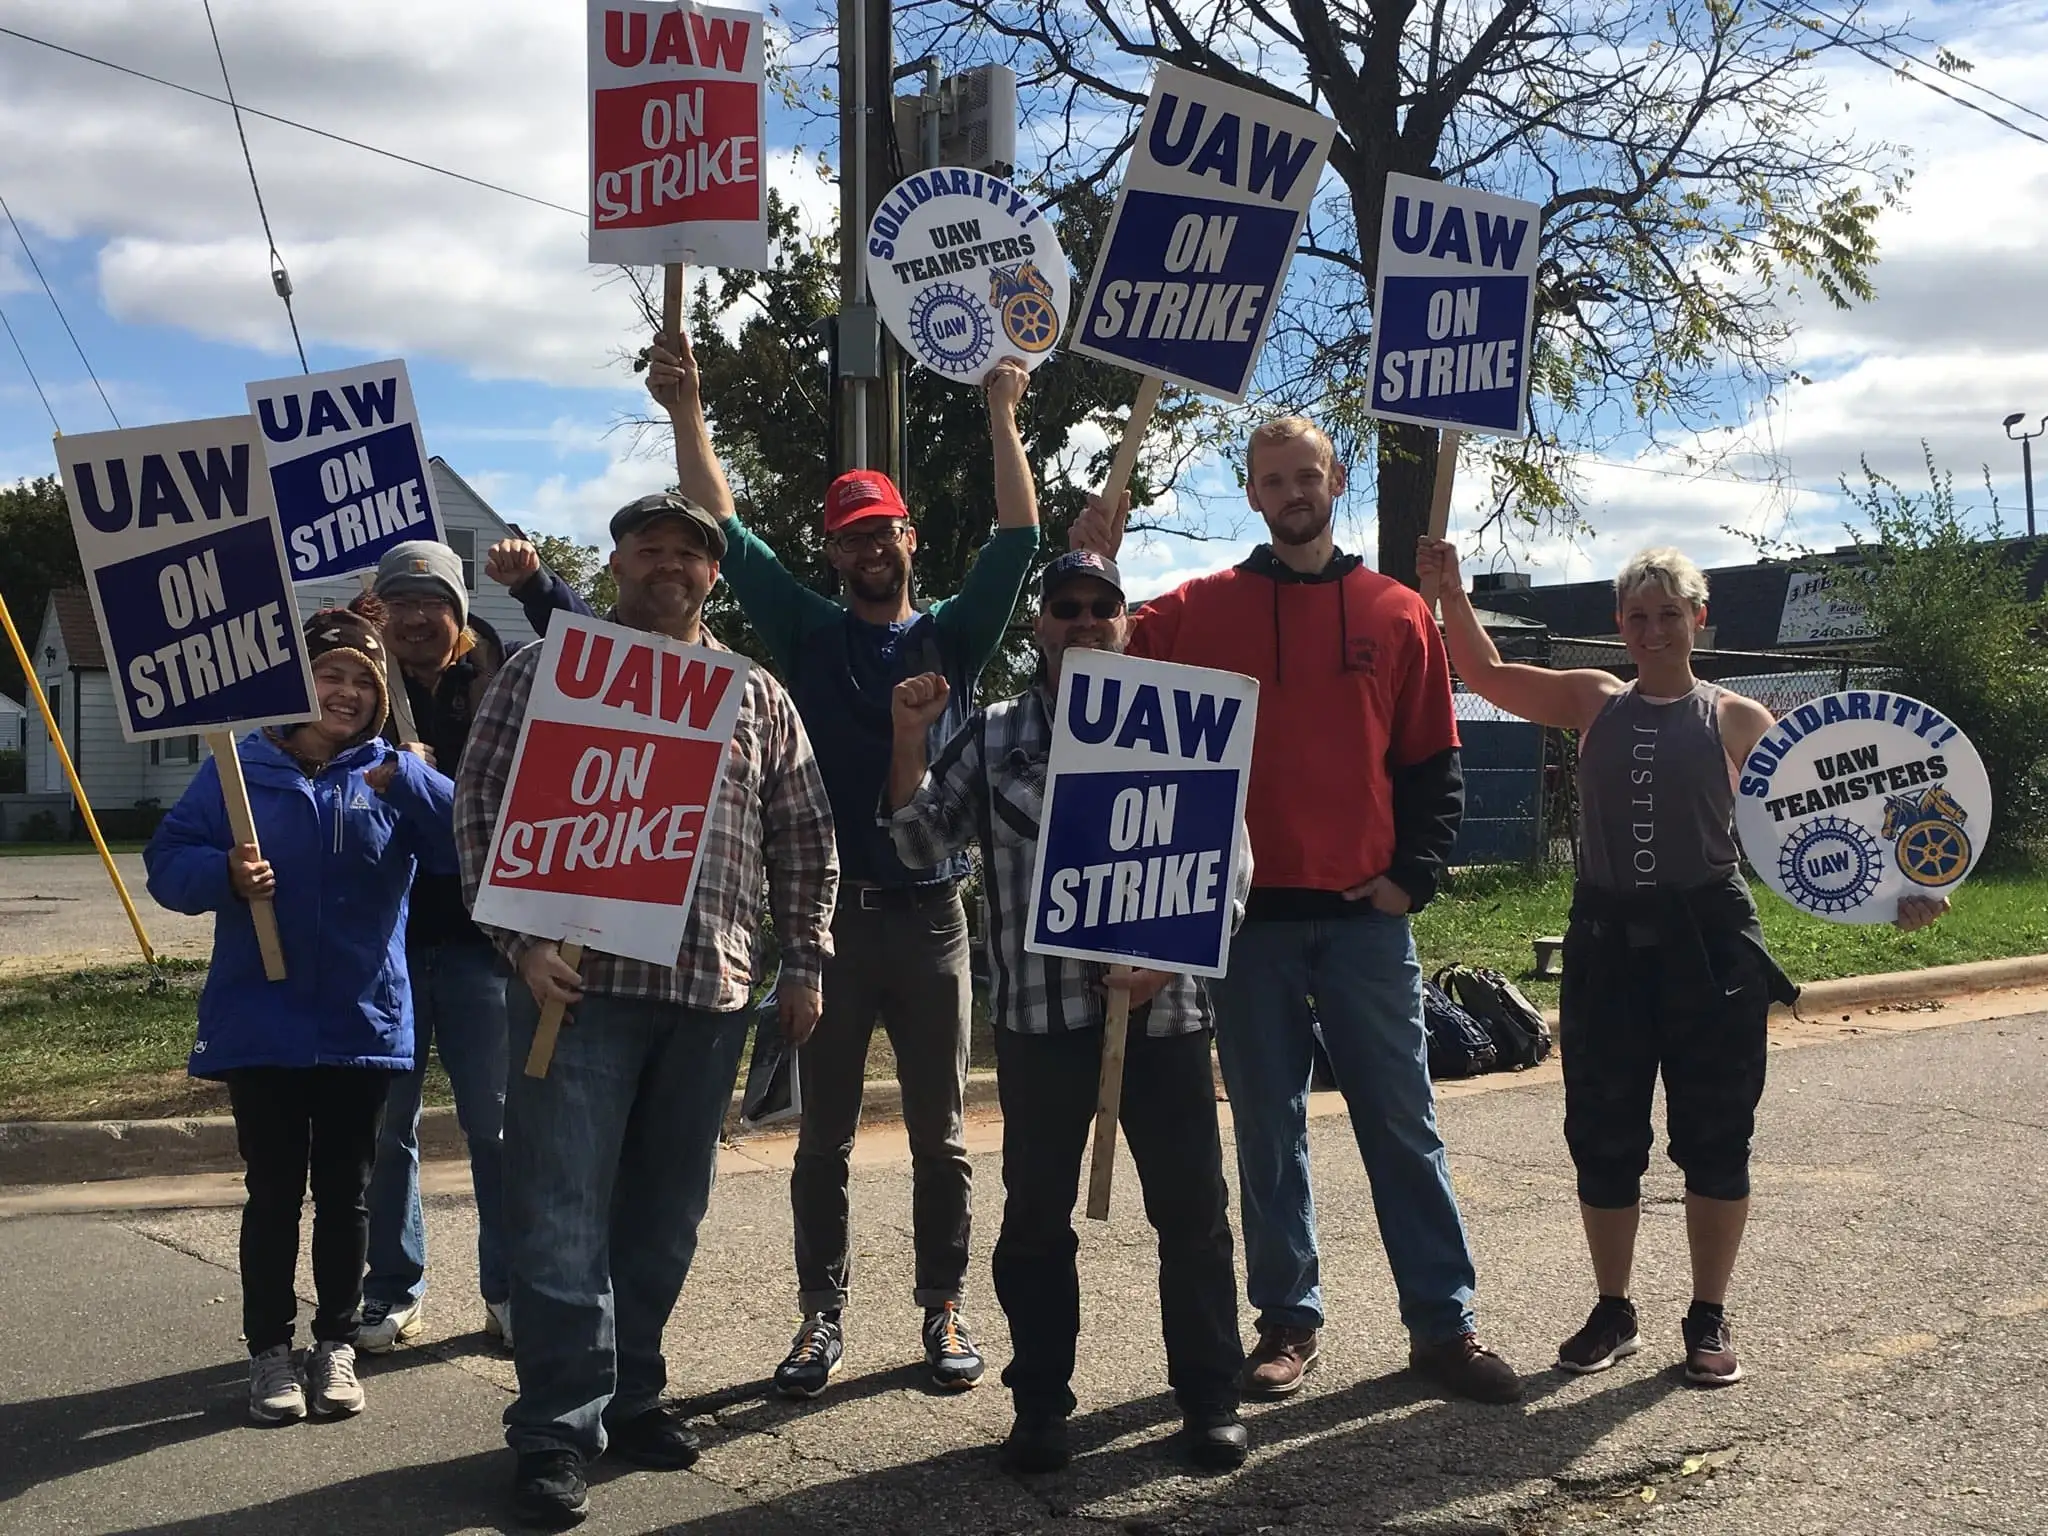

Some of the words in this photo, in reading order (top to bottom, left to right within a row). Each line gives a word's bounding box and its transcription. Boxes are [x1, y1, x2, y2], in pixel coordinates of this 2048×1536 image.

[605, 9, 750, 73] UAW
[642, 87, 704, 149] ON
[1150, 92, 1318, 202] UAW
[596, 136, 757, 222] STRIKE
[869, 169, 1039, 260] SOLIDARITY!
[928, 219, 982, 249] UAW
[1163, 213, 1239, 273] ON
[1392, 196, 1529, 271] UAW
[892, 233, 1036, 284] TEAMSTERS
[932, 315, 967, 340] UAW
[1094, 279, 1264, 342] STRIKE
[1427, 287, 1481, 341] ON
[1380, 339, 1516, 402] STRIKE
[257, 377, 397, 443] UAW
[72, 443, 250, 533] UAW
[320, 446, 375, 503] ON
[290, 478, 426, 572] STRIKE
[158, 548, 226, 630] ON
[128, 601, 291, 720] STRIKE
[555, 627, 735, 731] UAW
[1068, 673, 1242, 763] UAW
[1739, 692, 1958, 798] SOLIDARITY!
[571, 742, 656, 806] ON
[1765, 755, 1948, 822] TEAMSTERS
[1813, 744, 1879, 781] UAW
[495, 805, 705, 879] STRIKE
[1109, 783, 1178, 852] ON
[1046, 850, 1221, 934] STRIKE
[1807, 850, 1849, 877] UAW
